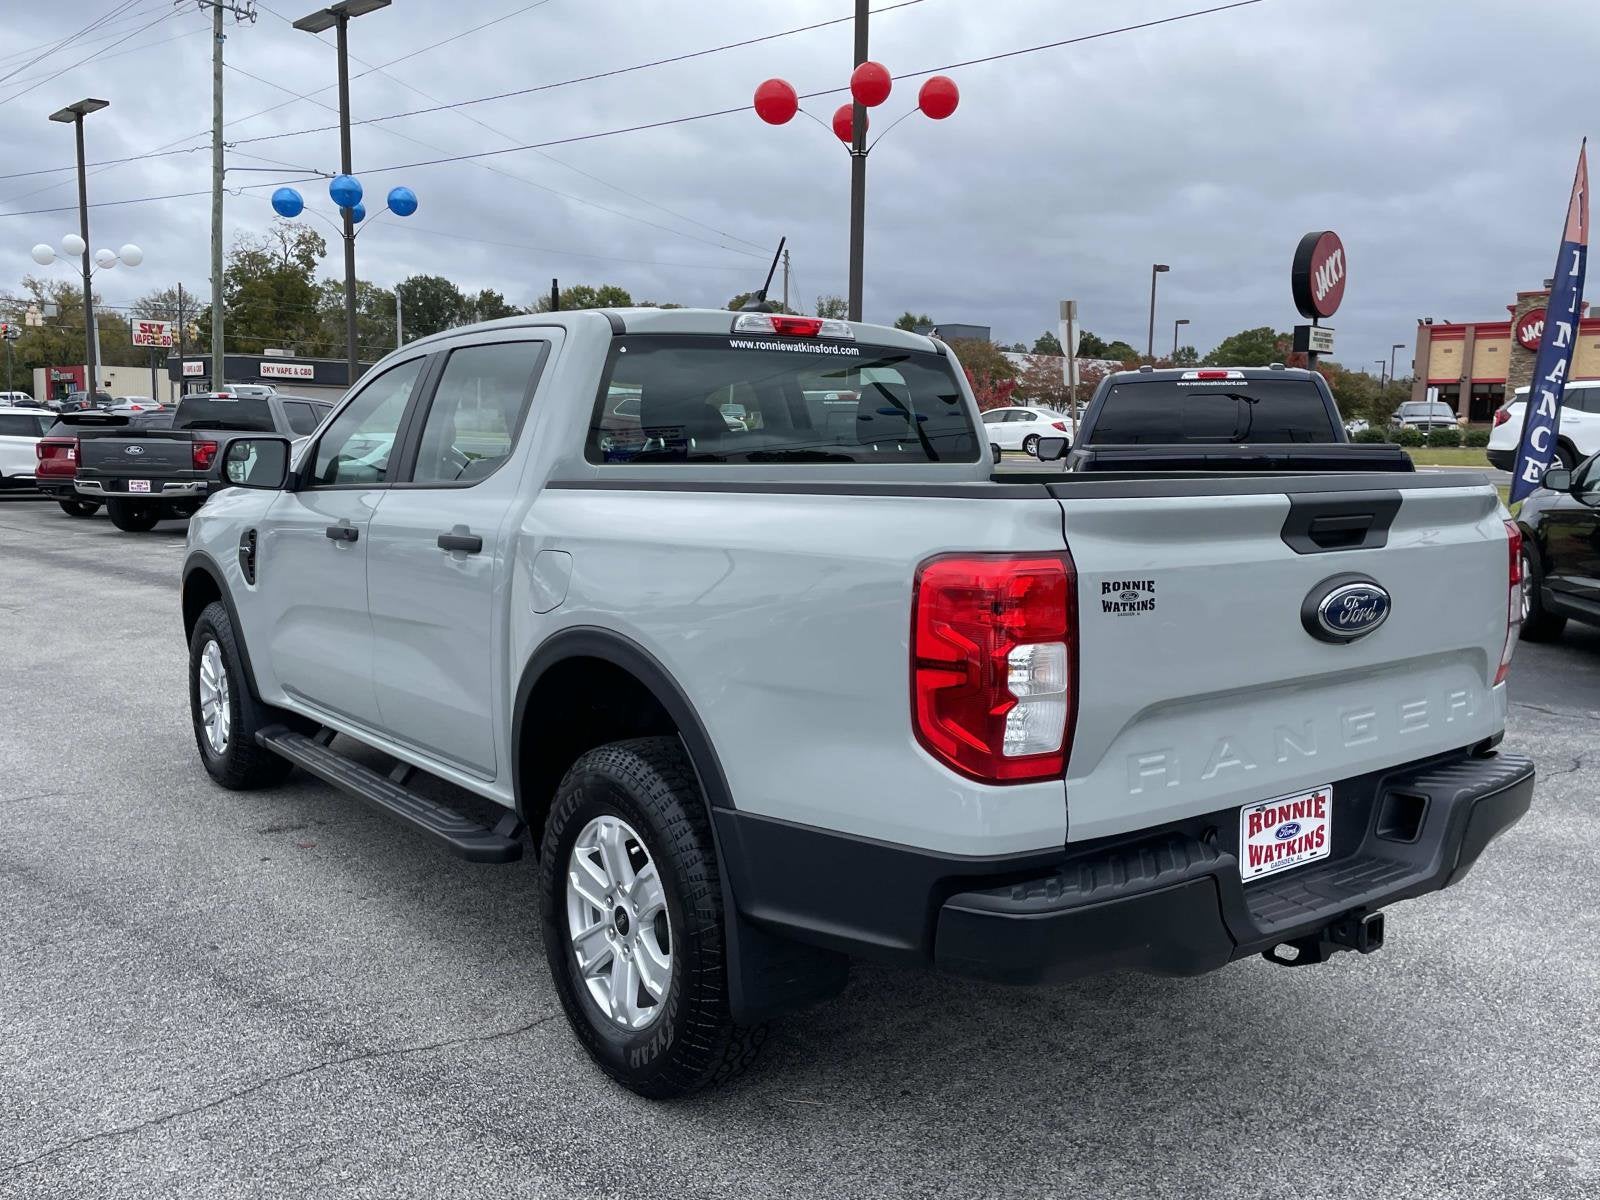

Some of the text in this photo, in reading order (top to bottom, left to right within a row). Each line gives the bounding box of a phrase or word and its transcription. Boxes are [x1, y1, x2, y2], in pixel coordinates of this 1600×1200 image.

[729, 339, 860, 356] www.ronniewatkinsford.com
[276, 367, 293, 375] VAPE
[1101, 580, 1155, 595] RONNIE
[1101, 598, 1155, 613] WATKINS
[1339, 595, 1377, 625] Ford
[1127, 688, 1476, 797] RANGER
[1247, 795, 1326, 840] RONNIE
[1278, 824, 1299, 838] Ford
[1247, 824, 1326, 868] WATKINS
